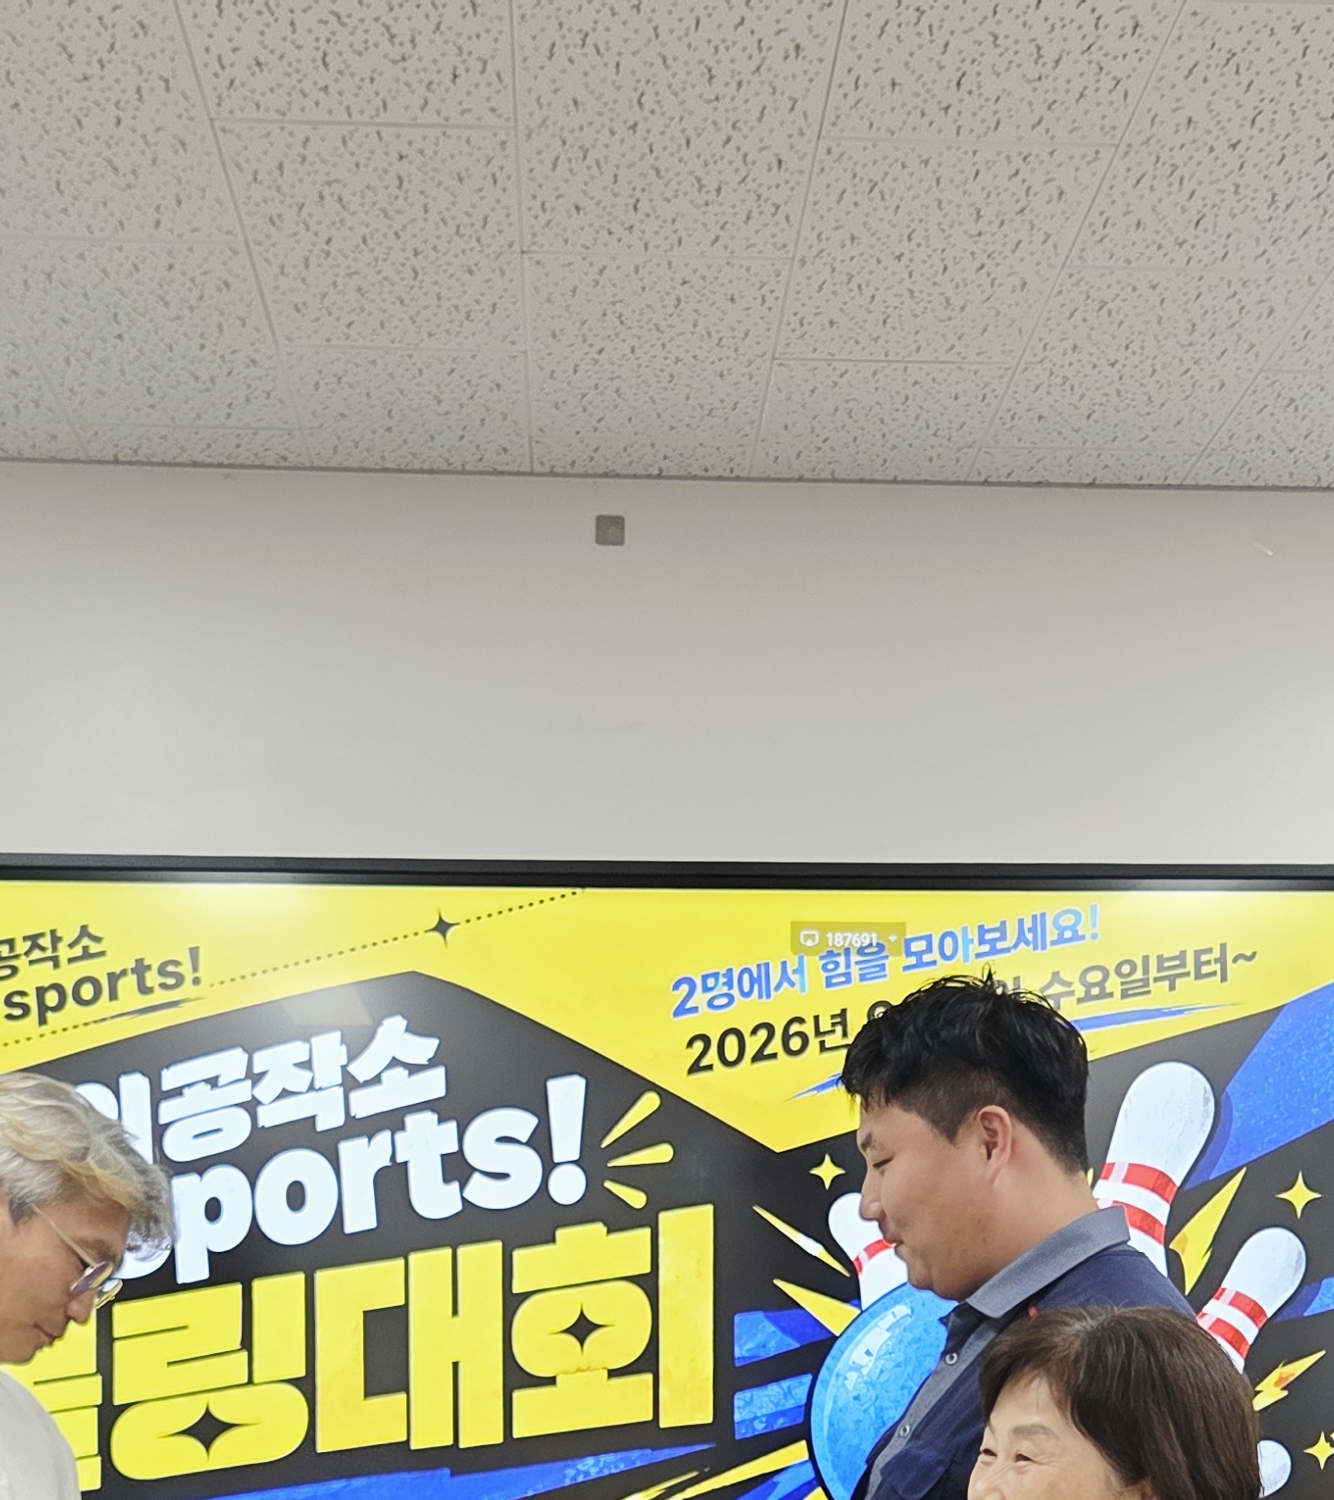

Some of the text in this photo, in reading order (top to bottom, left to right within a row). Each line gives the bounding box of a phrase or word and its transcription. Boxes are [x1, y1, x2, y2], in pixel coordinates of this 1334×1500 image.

[670, 903, 1101, 1019] 2명에서 힘을 모아보세요!
[826, 931, 878, 948] 187691
[685, 941, 1258, 1077] 2026년 수요일부터~
[110, 1072, 588, 1285] ports!
